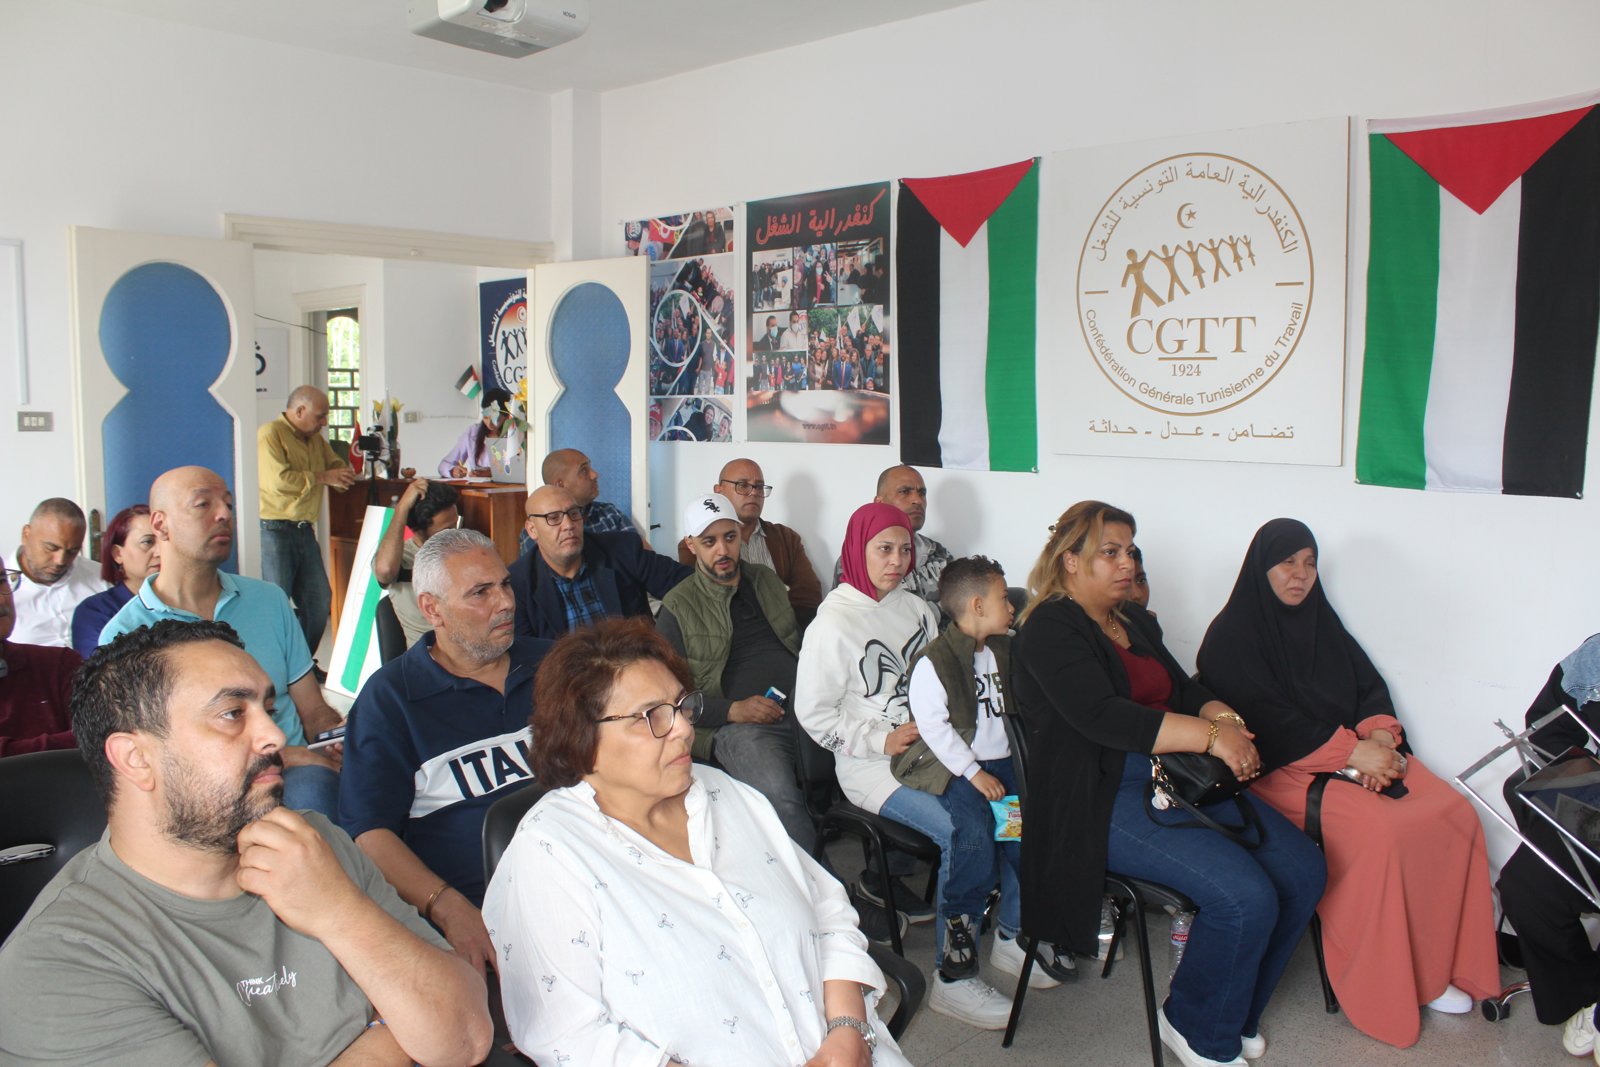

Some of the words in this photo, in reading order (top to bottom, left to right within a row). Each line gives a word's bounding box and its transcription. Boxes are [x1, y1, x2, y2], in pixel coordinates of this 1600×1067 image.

[1118, 165, 1178, 209] التونسية
[1185, 162, 1235, 184] العامة
[755, 211, 802, 245] الشغل
[1091, 209, 1121, 261] للشغل
[1126, 316, 1257, 354] CGTT
[1086, 309, 1137, 387] Confédération
[1138, 382, 1194, 405] Générale
[1197, 367, 1265, 404] Tunisienne
[1264, 350, 1281, 368] du
[1275, 302, 1303, 348] Travail
[1171, 364, 1201, 377] 1924
[1088, 419, 1138, 435] حداثة
[1160, 421, 1204, 439] عدل
[1227, 423, 1294, 442] تضامن
